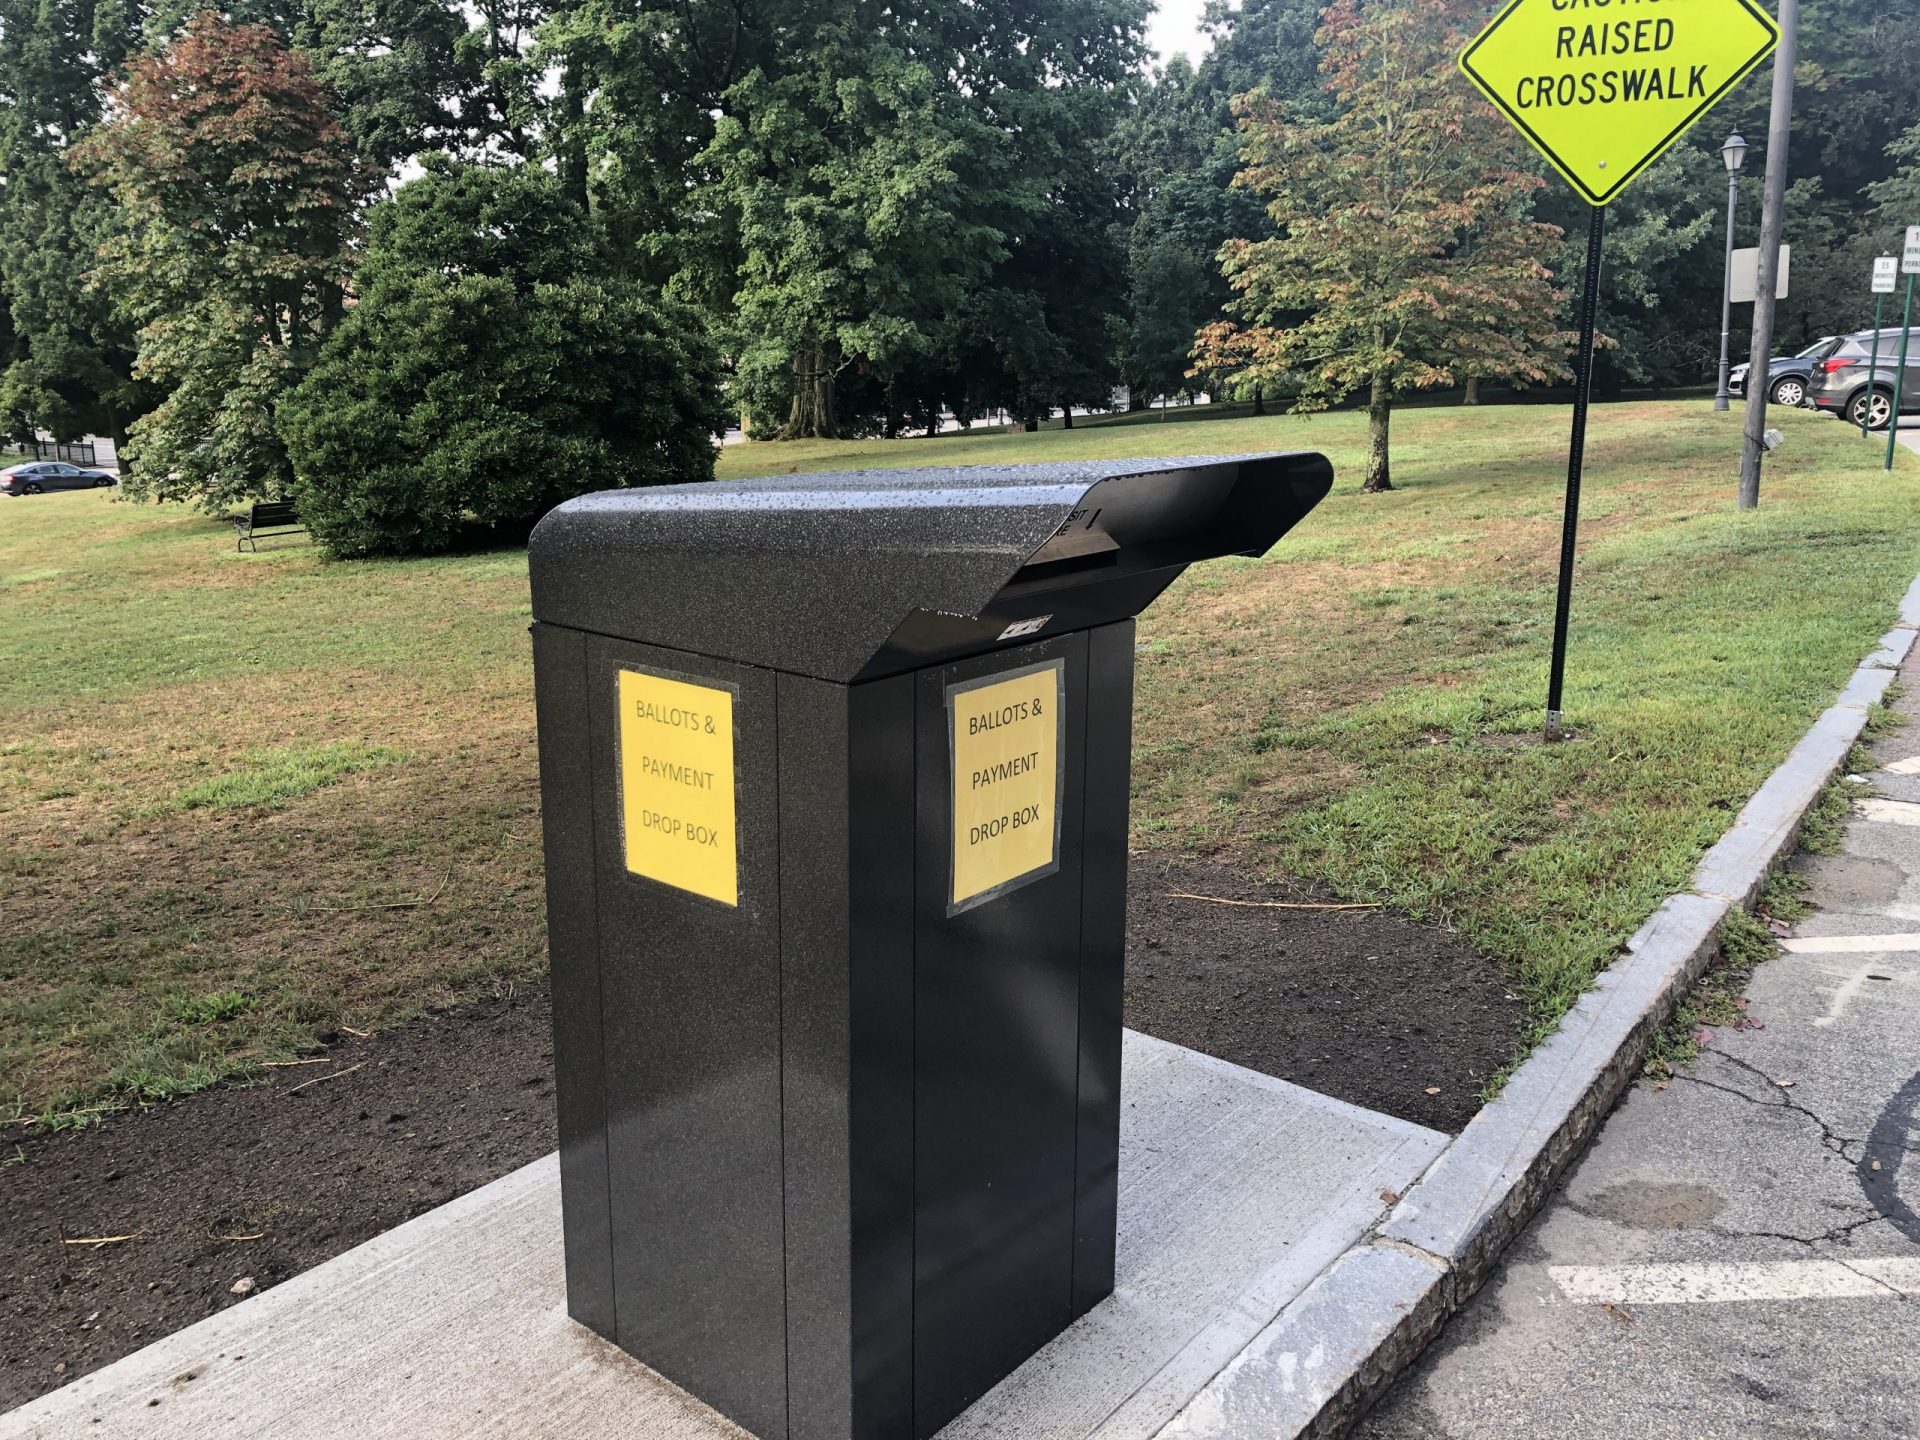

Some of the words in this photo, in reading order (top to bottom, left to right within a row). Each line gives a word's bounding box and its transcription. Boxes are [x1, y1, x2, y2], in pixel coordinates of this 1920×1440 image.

[1556, 18, 1675, 59] RAISED
[1516, 65, 1708, 109] CROSSWALK
[636, 700, 700, 732] BALLOTS
[704, 714, 717, 736] &
[969, 702, 1028, 736] BALLOTS
[1031, 698, 1043, 716] &
[642, 755, 714, 791] PAYMENT
[972, 752, 1039, 790] PAYMENT
[642, 809, 682, 837] DROP
[686, 822, 719, 848] BOX
[970, 815, 1009, 846] DROP
[1012, 804, 1040, 830] BOX
